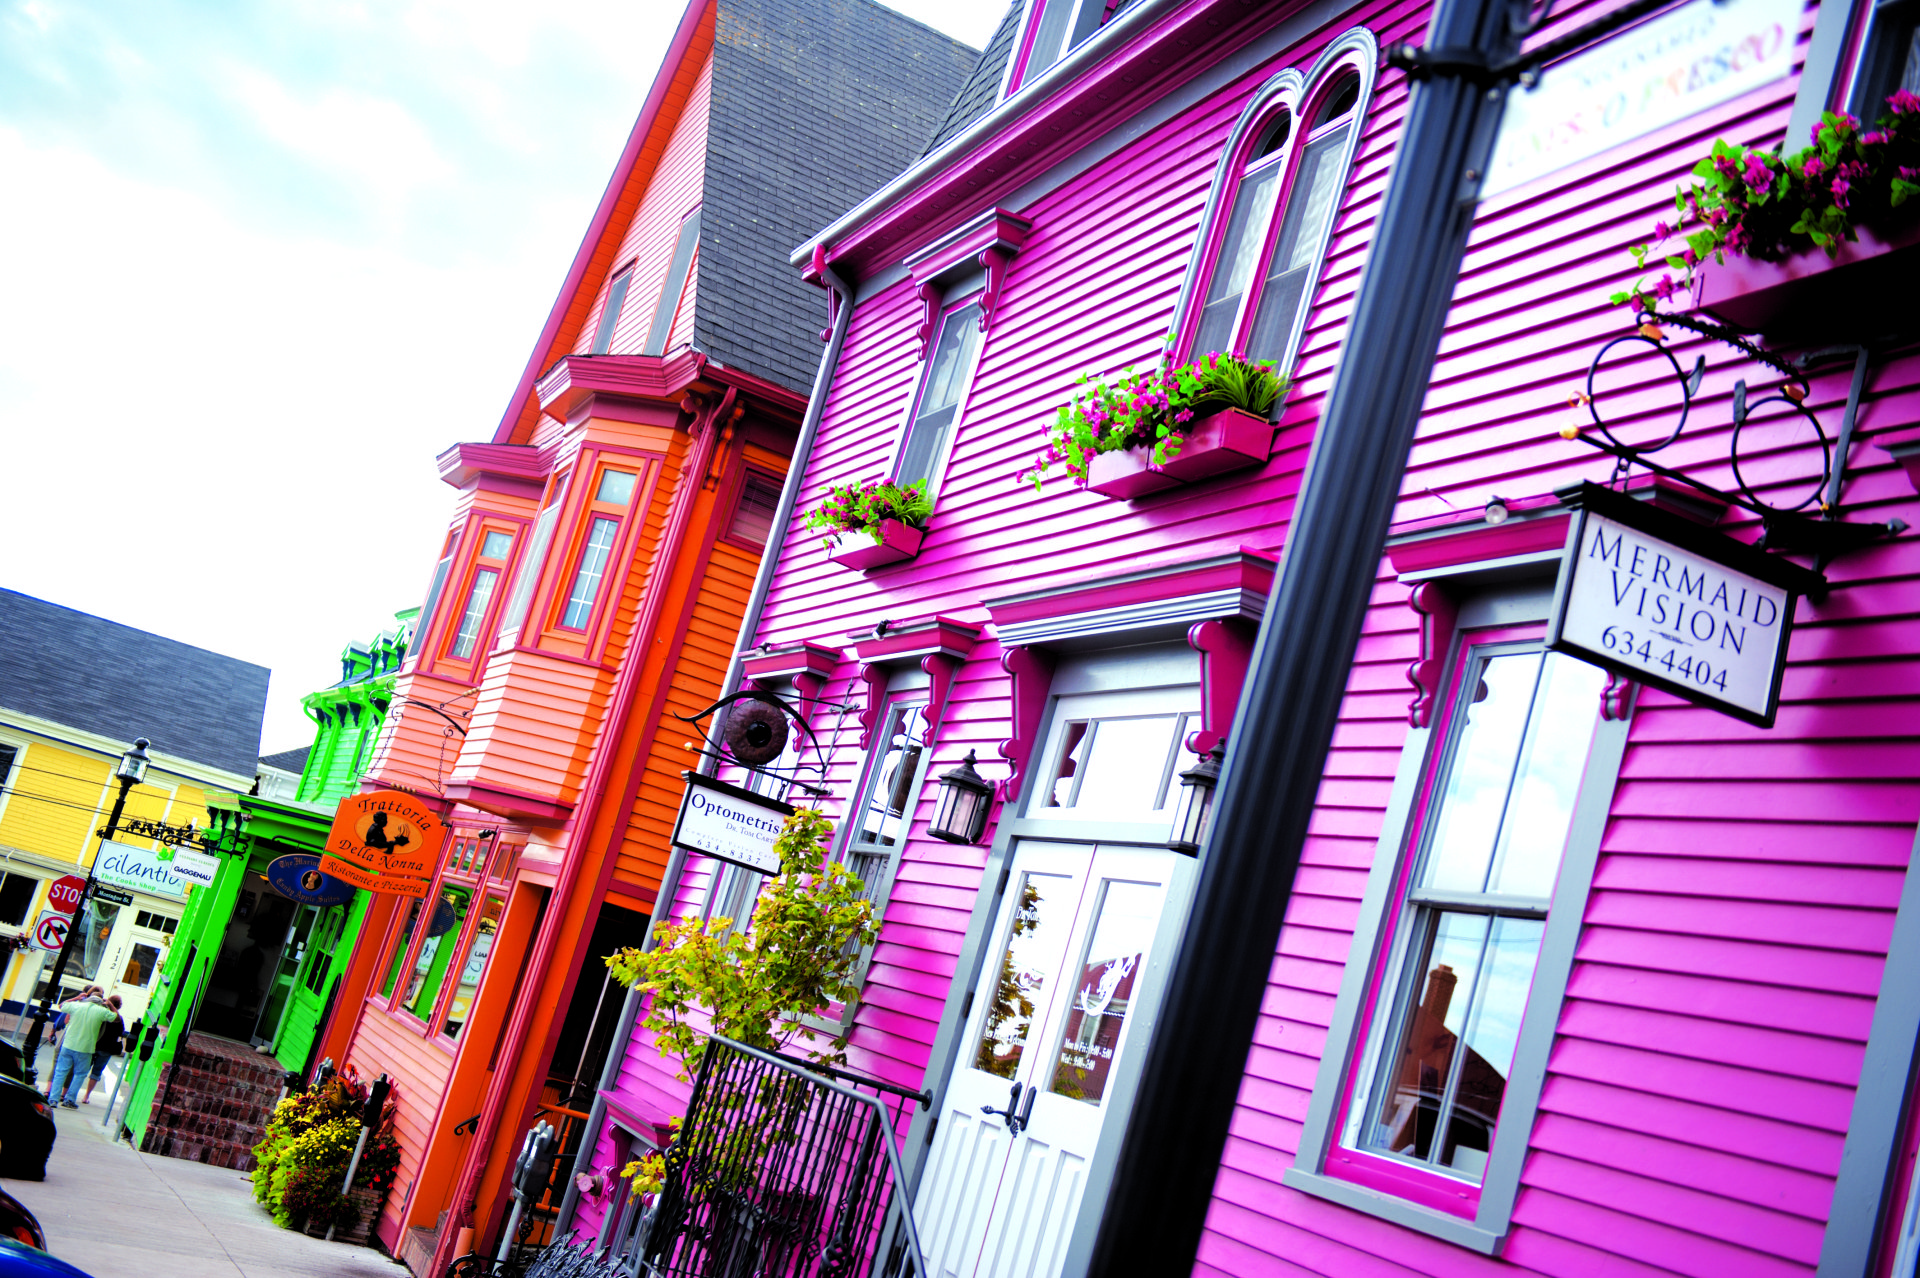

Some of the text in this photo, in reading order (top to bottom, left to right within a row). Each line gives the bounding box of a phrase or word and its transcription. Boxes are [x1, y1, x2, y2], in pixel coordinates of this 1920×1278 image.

[1589, 525, 1777, 627] MERMAID
[1611, 568, 1746, 655] VISION
[1601, 625, 1728, 692] 634-4404
[358, 798, 431, 831] Trattoria
[278, 859, 293, 869] The
[338, 839, 423, 871] Della Nonna
[697, 839, 761, 865] 634-8337
[101, 872, 156, 891] The Cooks Shop
[173, 865, 211, 881] GAGGENAU
[327, 861, 373, 886] Ristorante
[373, 880, 380, 888] e
[381, 881, 422, 893] Pizzeria
[51, 883, 83, 904] STO
[276, 878, 295, 896] Candy
[294, 890, 315, 903] Apple
